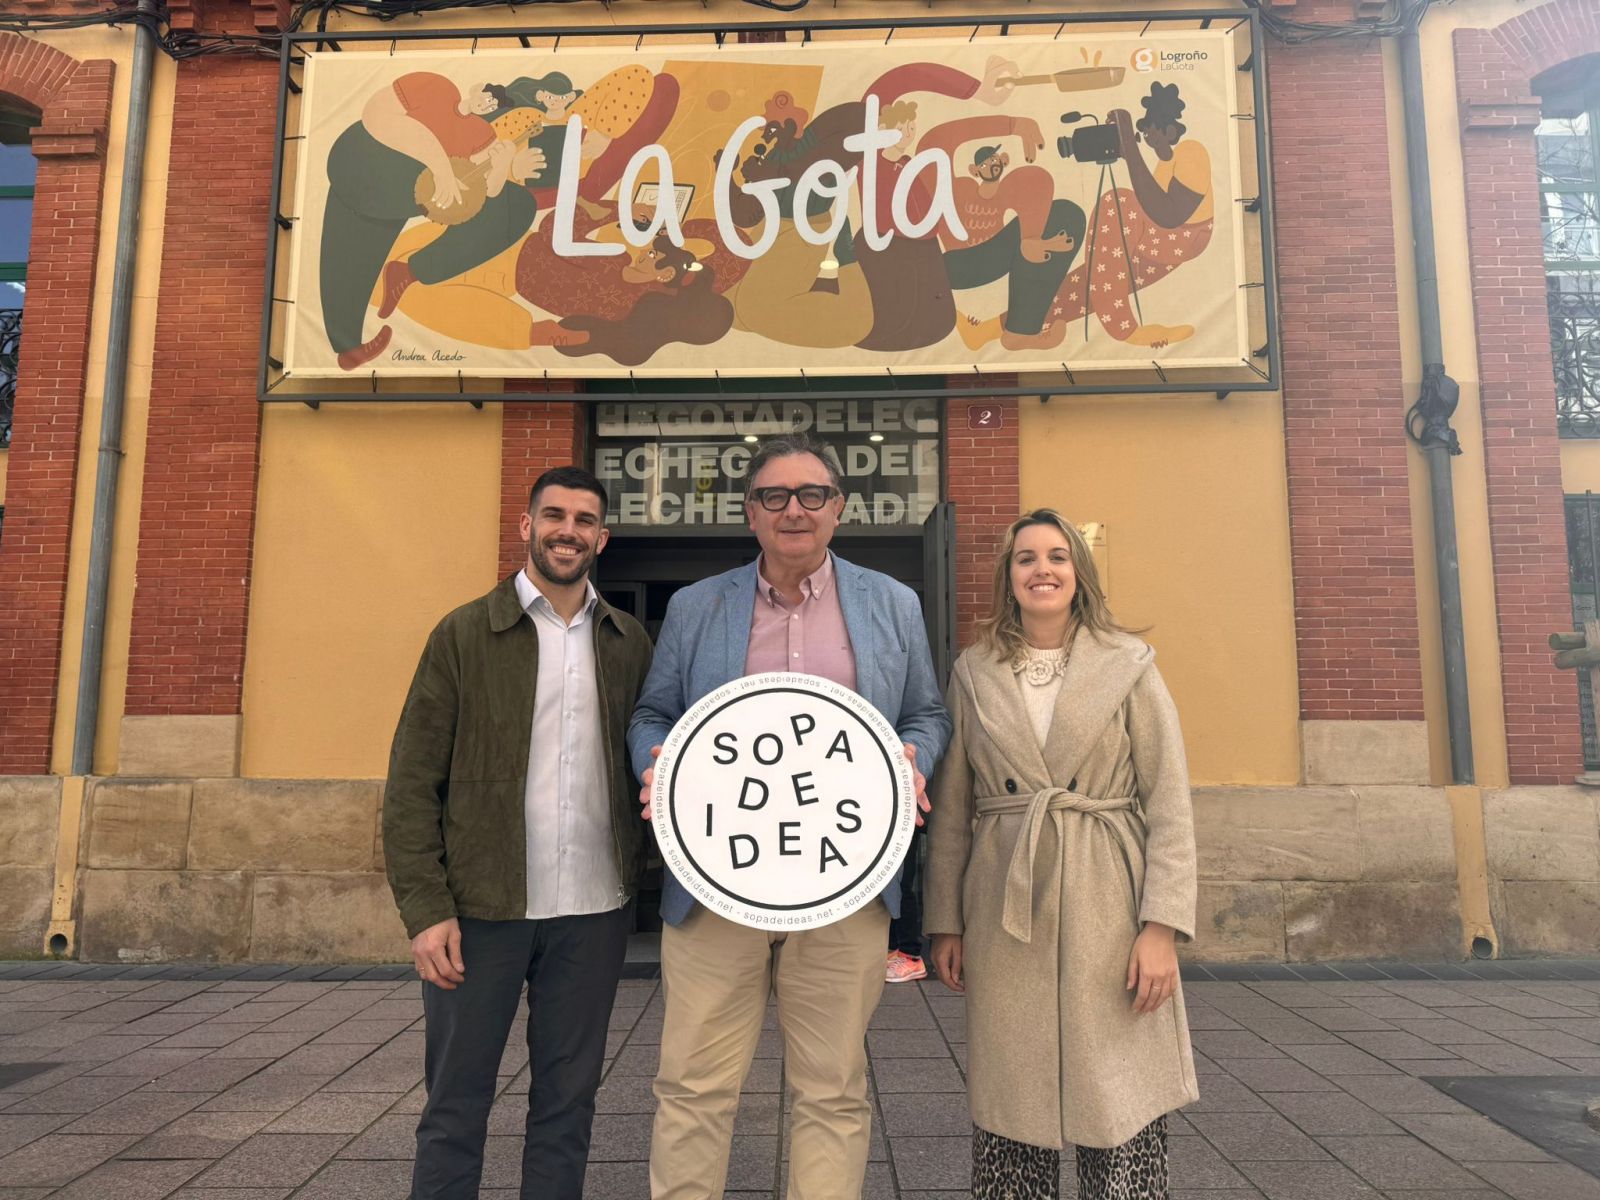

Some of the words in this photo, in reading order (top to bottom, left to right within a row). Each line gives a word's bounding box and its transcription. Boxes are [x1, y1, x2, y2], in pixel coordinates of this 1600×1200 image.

[1160, 50, 1208, 62] Logroño
[552, 113, 685, 256] La
[713, 94, 968, 260] Gota
[391, 347, 427, 361] Andrea
[978, 410, 992, 424] 2
[712, 712, 854, 766] SOPA
[737, 771, 819, 811] DE
[705, 798, 862, 873] IDEAS
[668, 849, 734, 913] sopadeideas.net
[843, 842, 903, 909] sopadeideas.net
[743, 909, 834, 925] sopadeideas.net
